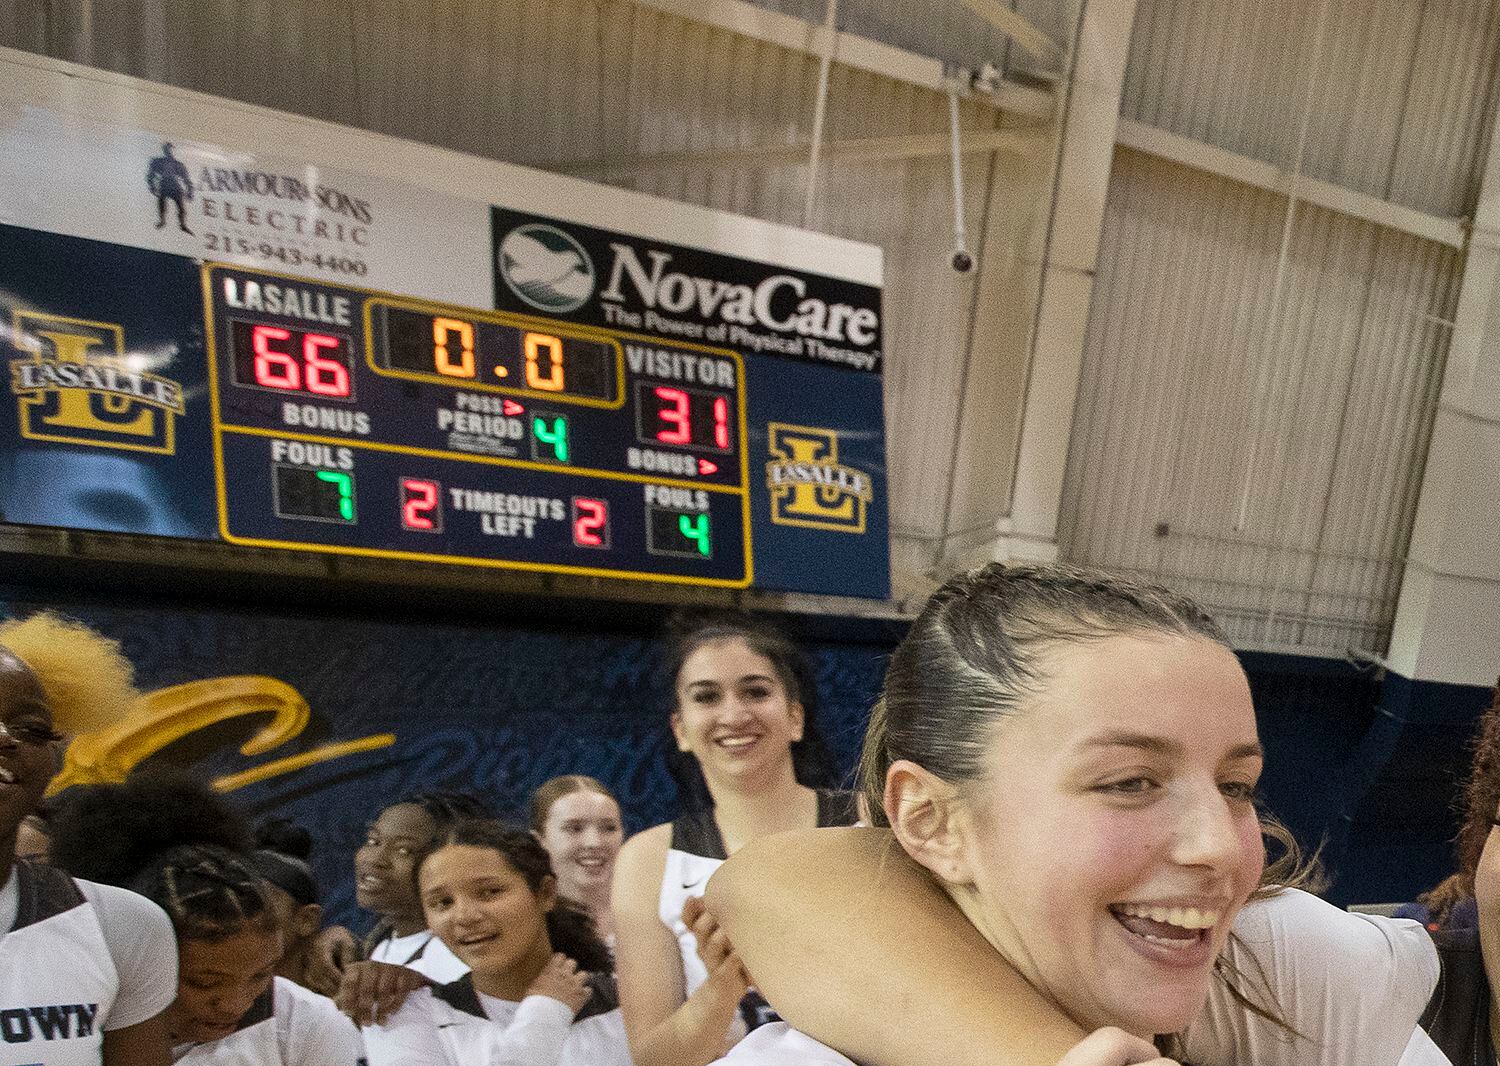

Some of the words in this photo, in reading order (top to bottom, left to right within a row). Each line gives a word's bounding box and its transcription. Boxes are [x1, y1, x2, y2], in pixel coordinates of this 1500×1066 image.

[202, 197, 369, 246] ELECTRIC
[203, 233, 368, 277] 215-943-4400
[223, 277, 350, 326] LASALLE
[601, 243, 878, 346] NovaCare
[601, 302, 642, 328] The
[645, 311, 703, 338] Power
[704, 323, 728, 343] of
[730, 326, 804, 354] Physical
[252, 324, 350, 398] 66
[433, 317, 565, 391] 0.0
[626, 344, 735, 388] VISITOR
[19, 361, 182, 410] LASALLE
[282, 402, 371, 436] BONUS
[437, 408, 524, 440] PERIOD
[532, 416, 569, 462] 4
[655, 386, 729, 449] 31
[271, 439, 354, 470] FOULS
[627, 447, 697, 476] BONUS
[771, 462, 865, 492] LASALLE
[316, 471, 353, 521] 7
[403, 479, 438, 529] 2
[450, 488, 567, 521] TIMEOUTS
[645, 485, 711, 511] FOULS
[481, 514, 537, 539] LEFT
[575, 499, 607, 546] 2
[679, 514, 710, 556] 4
[0, 1003, 97, 1043] OWN
